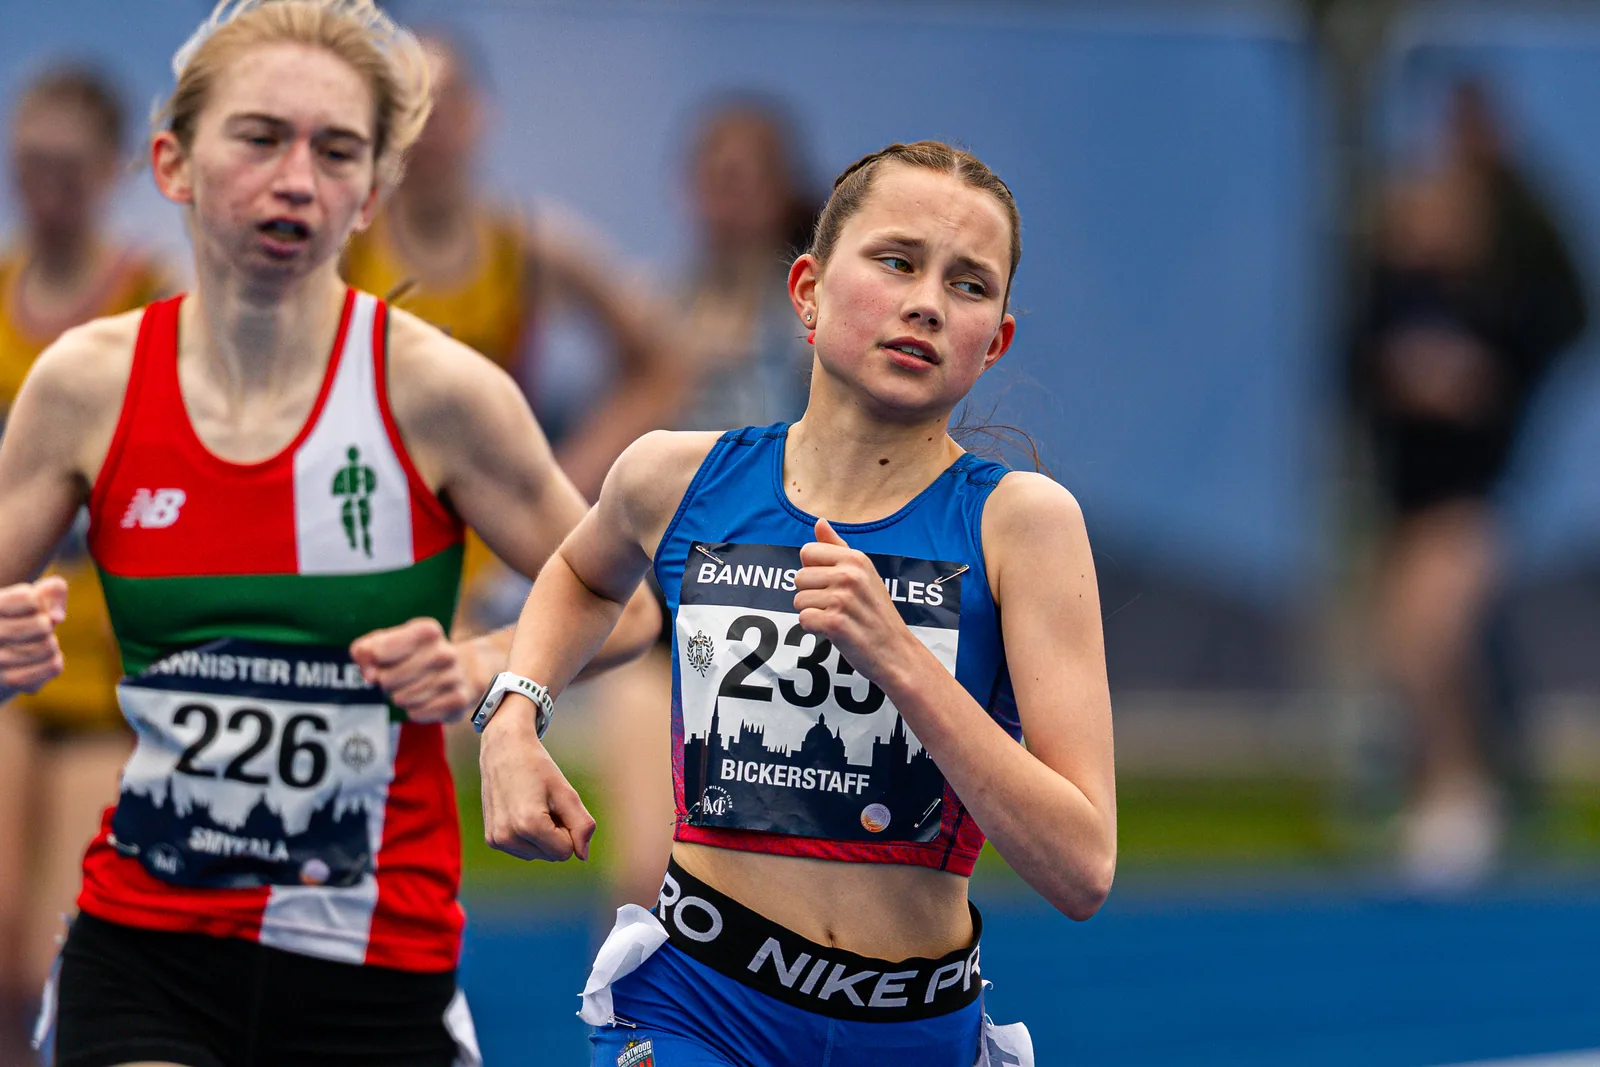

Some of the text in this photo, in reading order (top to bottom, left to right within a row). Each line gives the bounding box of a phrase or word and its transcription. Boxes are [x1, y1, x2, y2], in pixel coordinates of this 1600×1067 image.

[697, 563, 944, 606] BANNIS ILES
[294, 661, 373, 690] MILE
[718, 615, 886, 714] 235
[172, 704, 330, 788] 226
[720, 758, 870, 795] BICKERSTAFF
[747, 936, 919, 1007] NIKE
